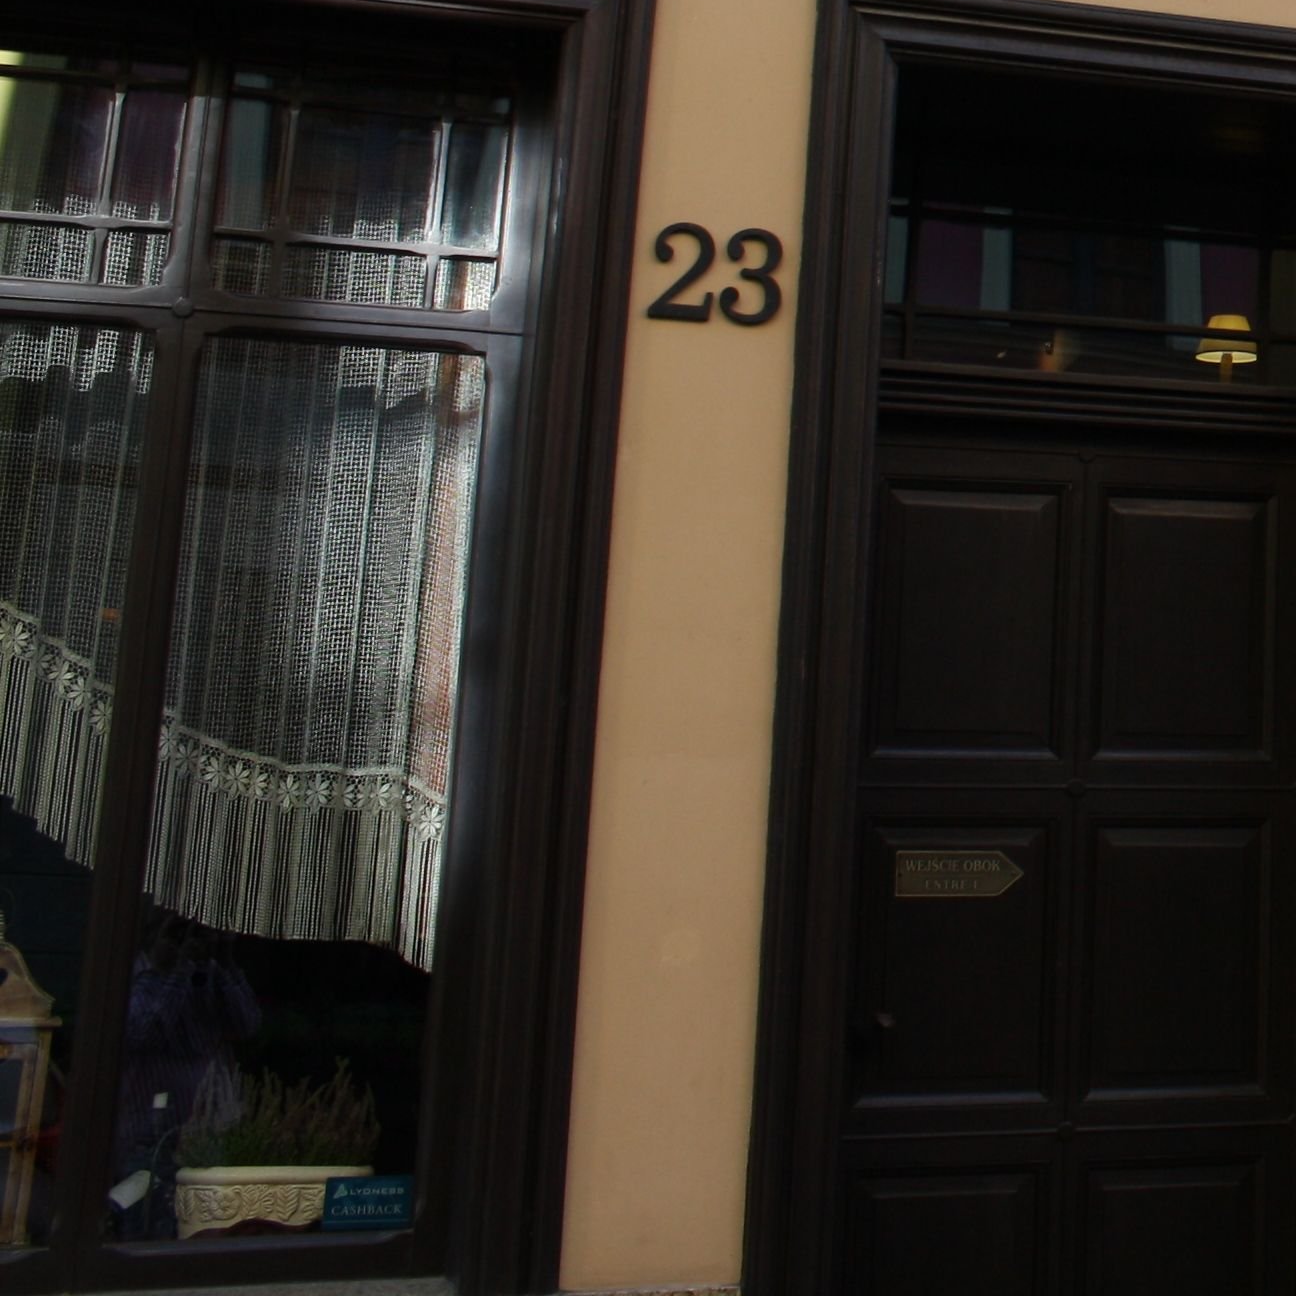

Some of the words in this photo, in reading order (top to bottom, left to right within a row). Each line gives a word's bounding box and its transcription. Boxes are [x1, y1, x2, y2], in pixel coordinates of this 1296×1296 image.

[648, 222, 783, 327] 23
[905, 857, 960, 872] WEJŚCIE
[963, 859, 1000, 872] OBOK
[331, 1204, 403, 1216] CASHBACK
